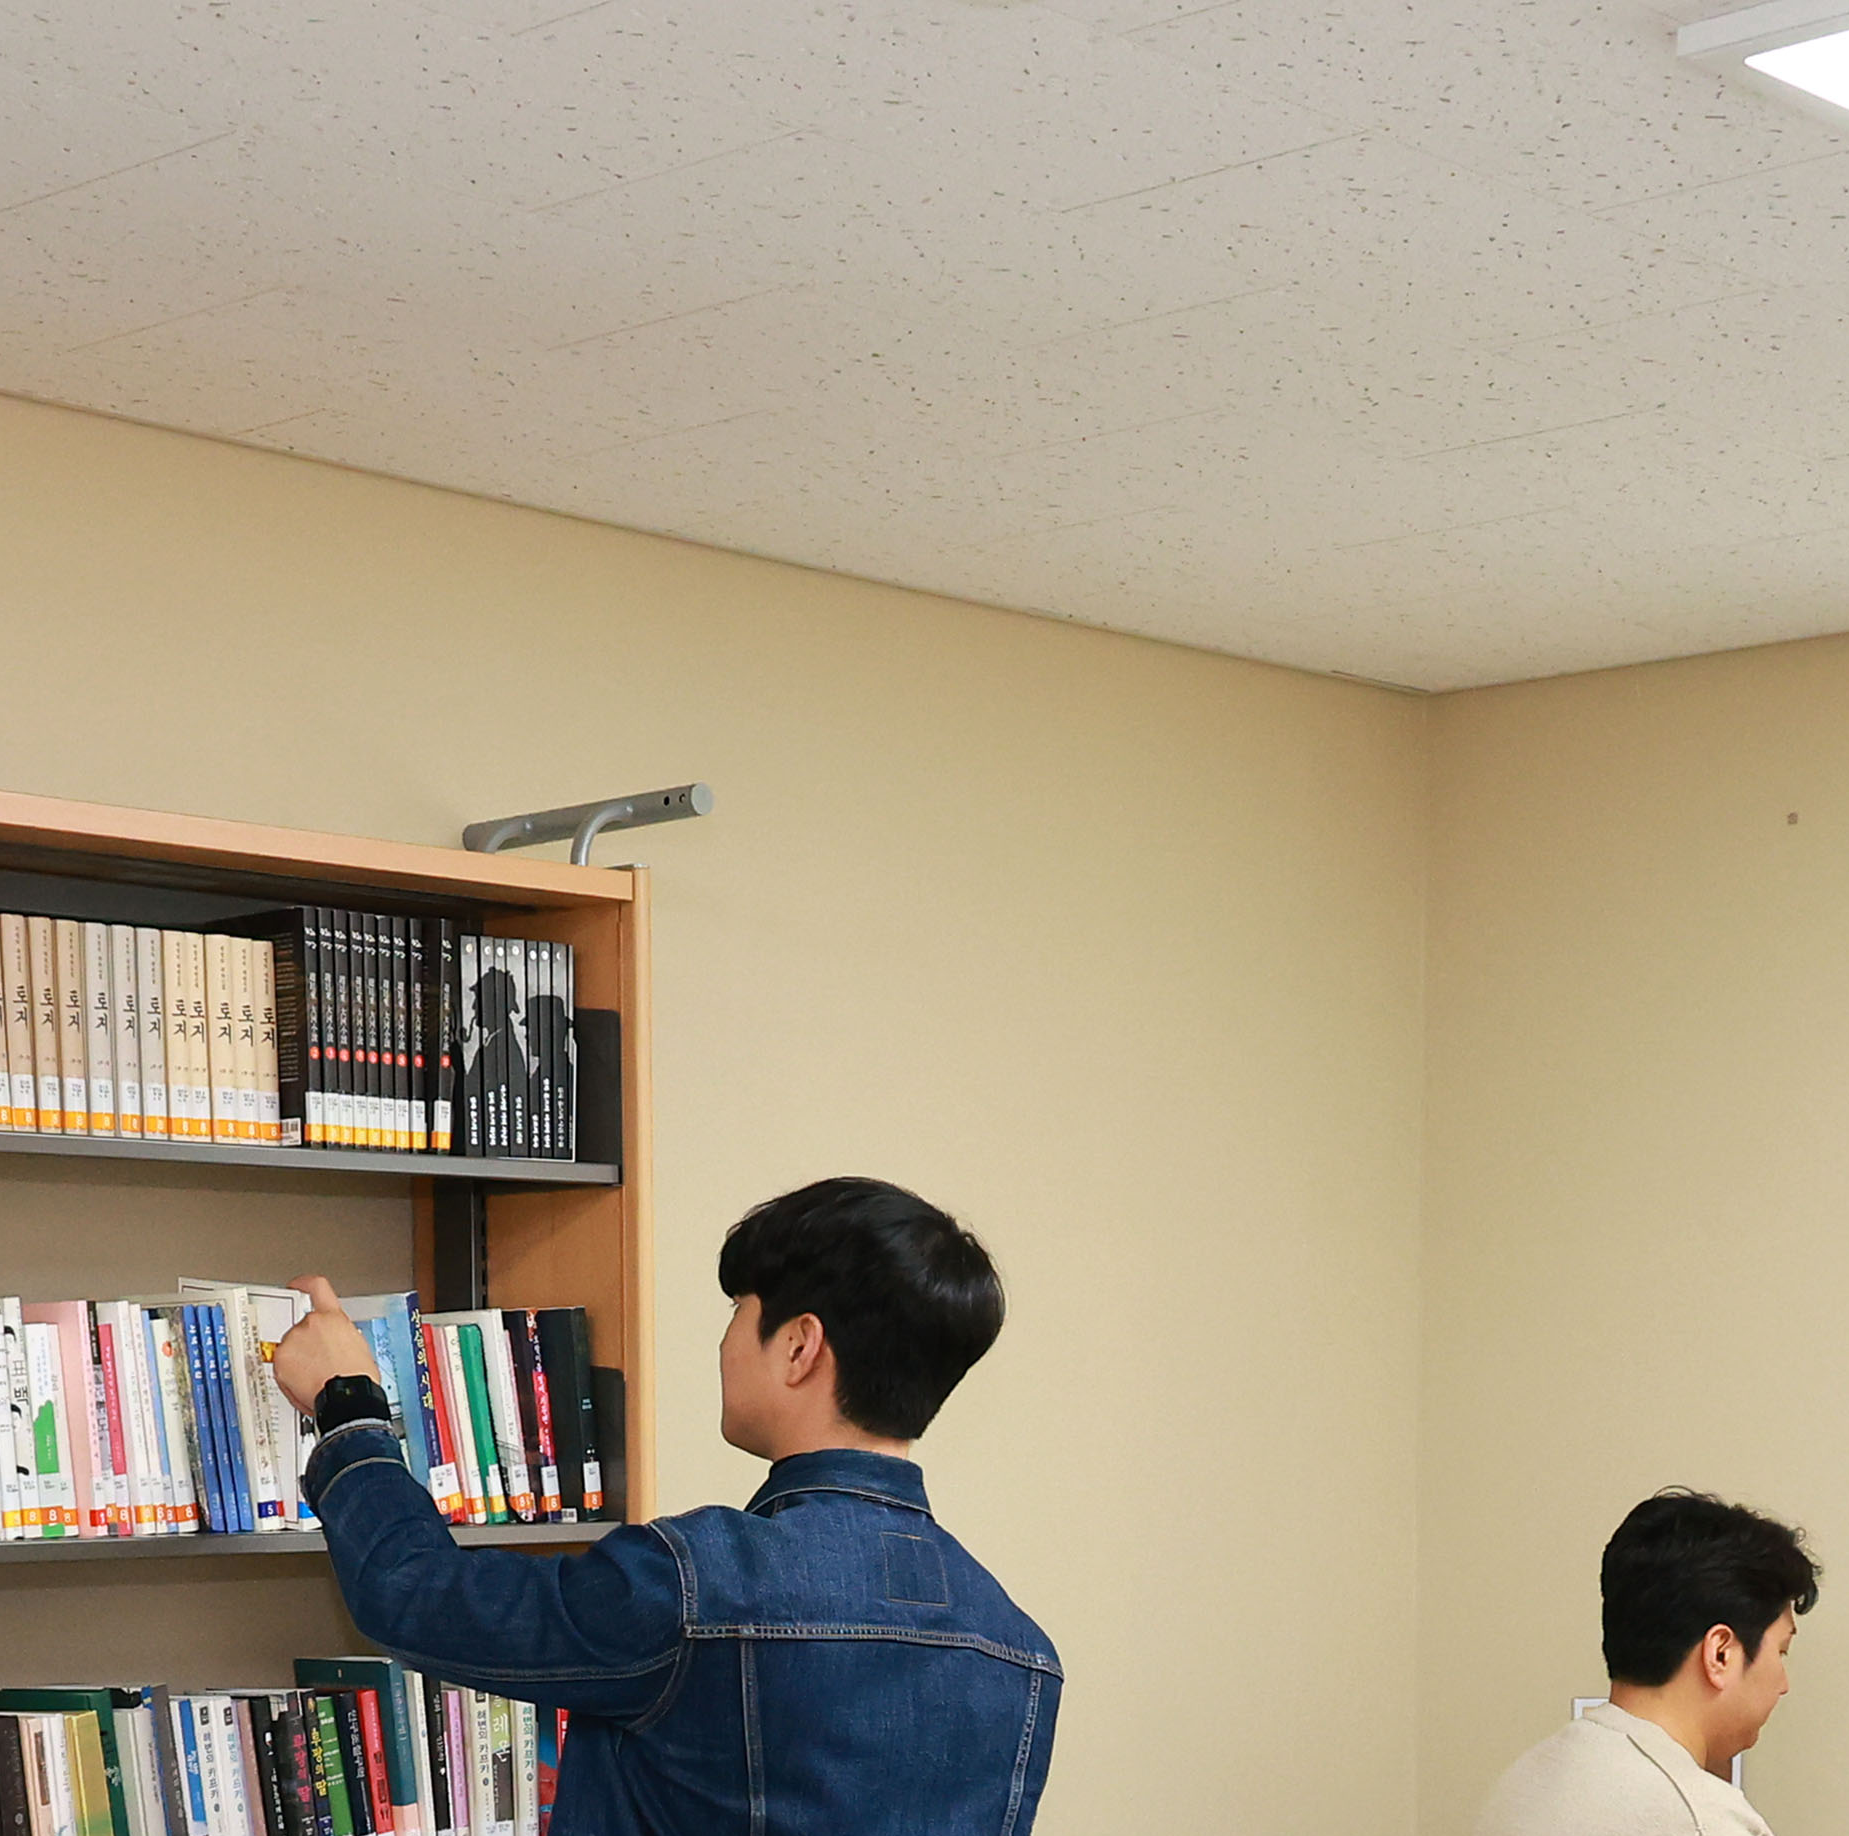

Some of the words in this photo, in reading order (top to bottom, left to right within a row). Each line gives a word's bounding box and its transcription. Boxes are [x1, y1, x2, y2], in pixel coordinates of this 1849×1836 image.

[67, 990, 81, 1036] 토지
[94, 992, 109, 1037] 토지
[123, 994, 136, 1039] 토지
[147, 996, 162, 1040] 토지
[190, 1000, 205, 1044] 토지
[217, 1002, 232, 1044] 토지
[217, 1002, 233, 1044] 토지
[238, 1005, 254, 1048] 토지
[260, 1006, 276, 1049] 토지
[476, 1709, 487, 1741] 해변의
[479, 1743, 490, 1775] 카프카
[524, 1739, 535, 1769] 카프카
